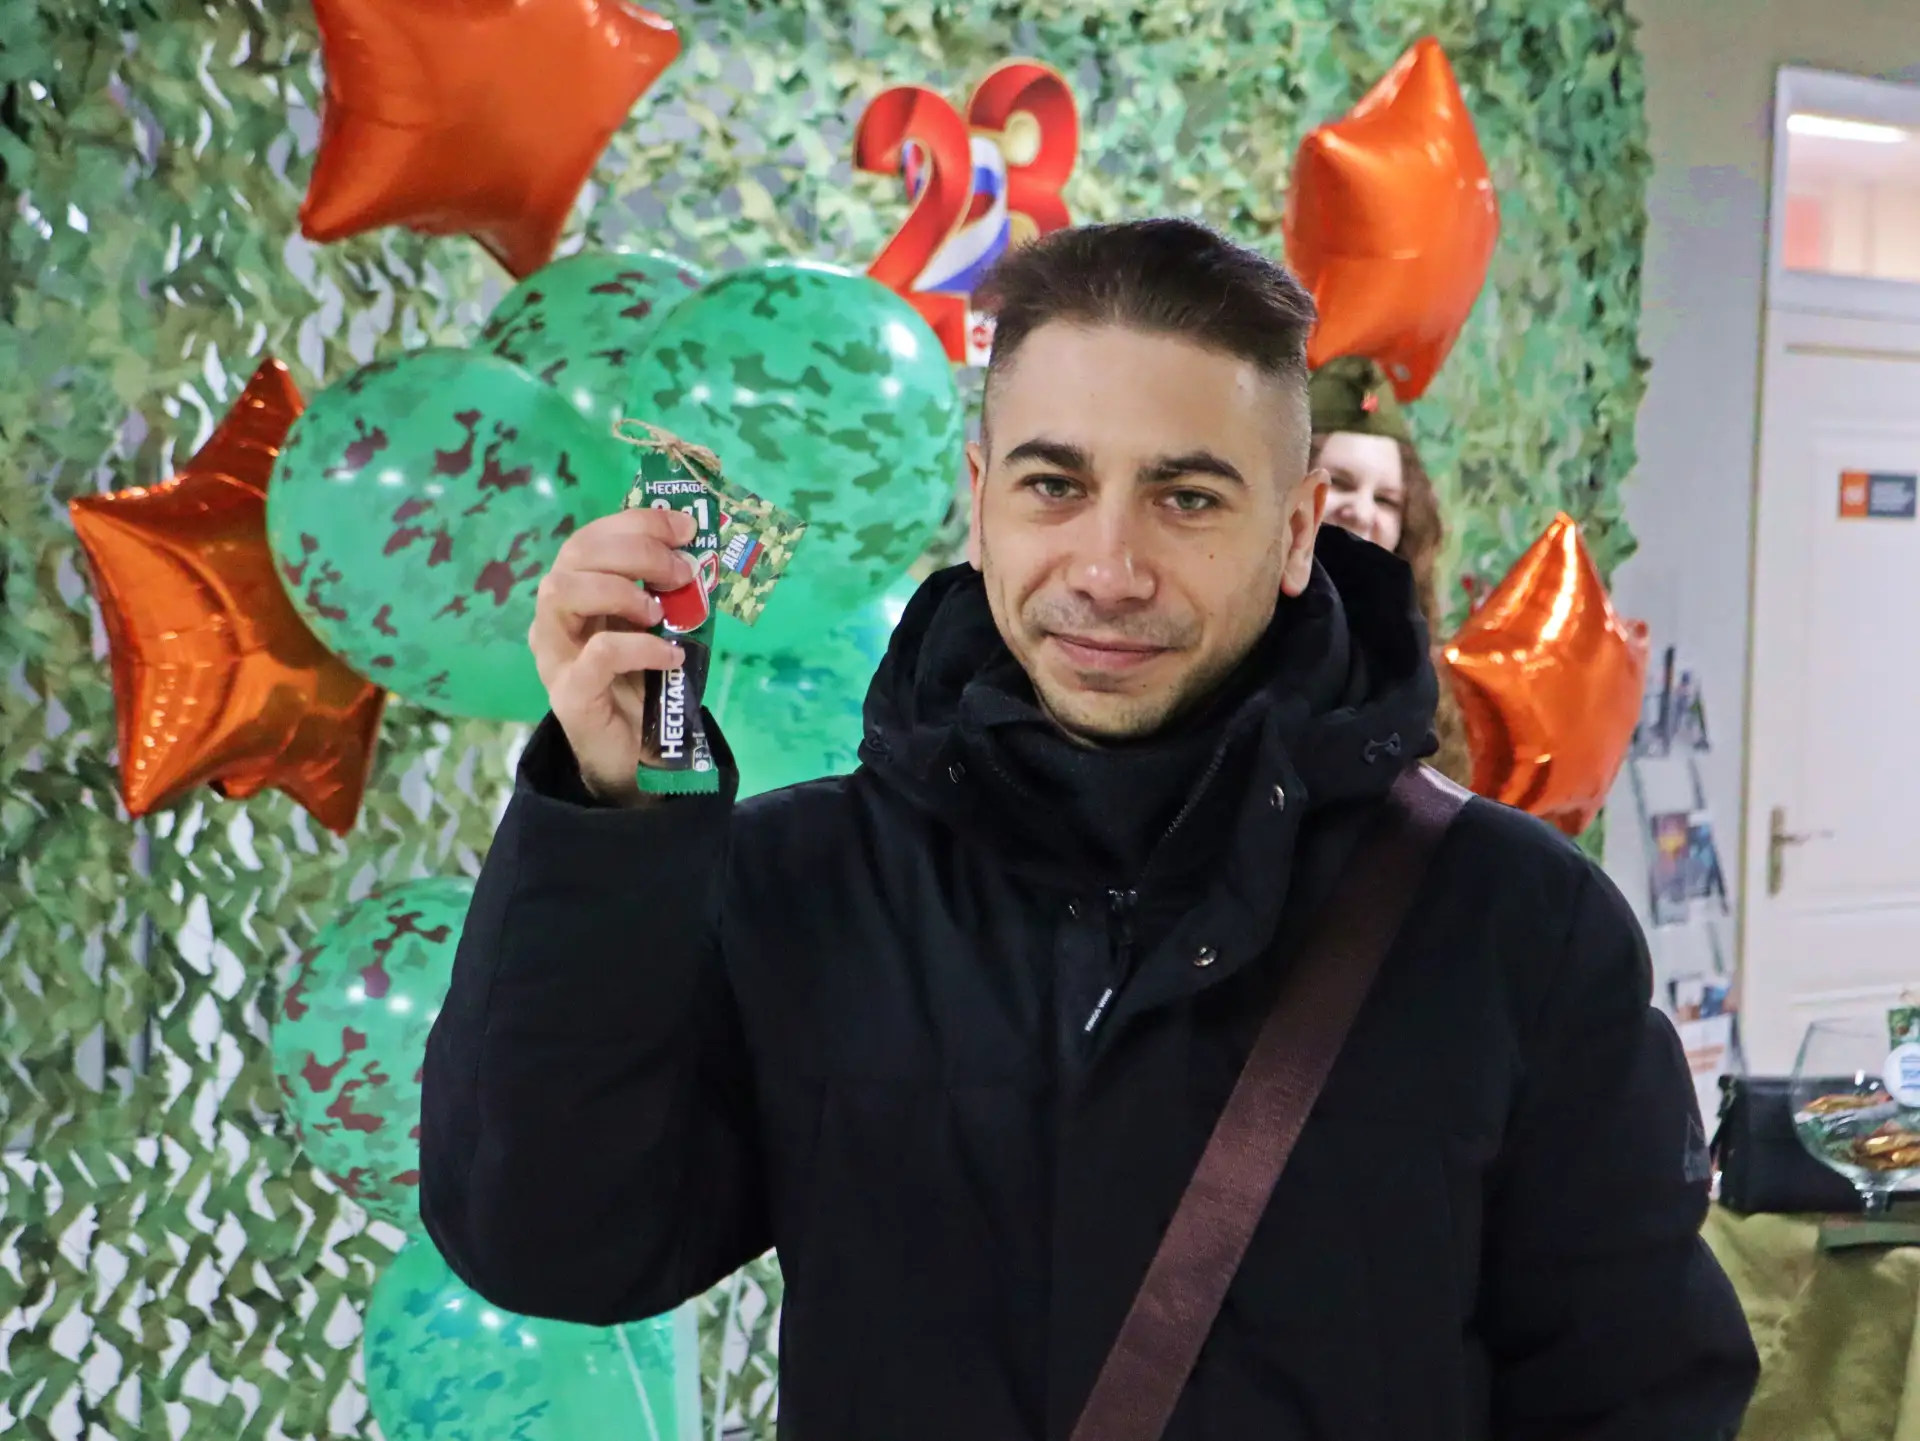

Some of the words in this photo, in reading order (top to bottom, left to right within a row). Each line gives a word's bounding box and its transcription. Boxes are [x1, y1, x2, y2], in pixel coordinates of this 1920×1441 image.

[645, 479, 708, 494] НЕСКАФЕ
[721, 533, 749, 570] ДЕНЬ
[1098, 988, 1113, 1007] WIND
